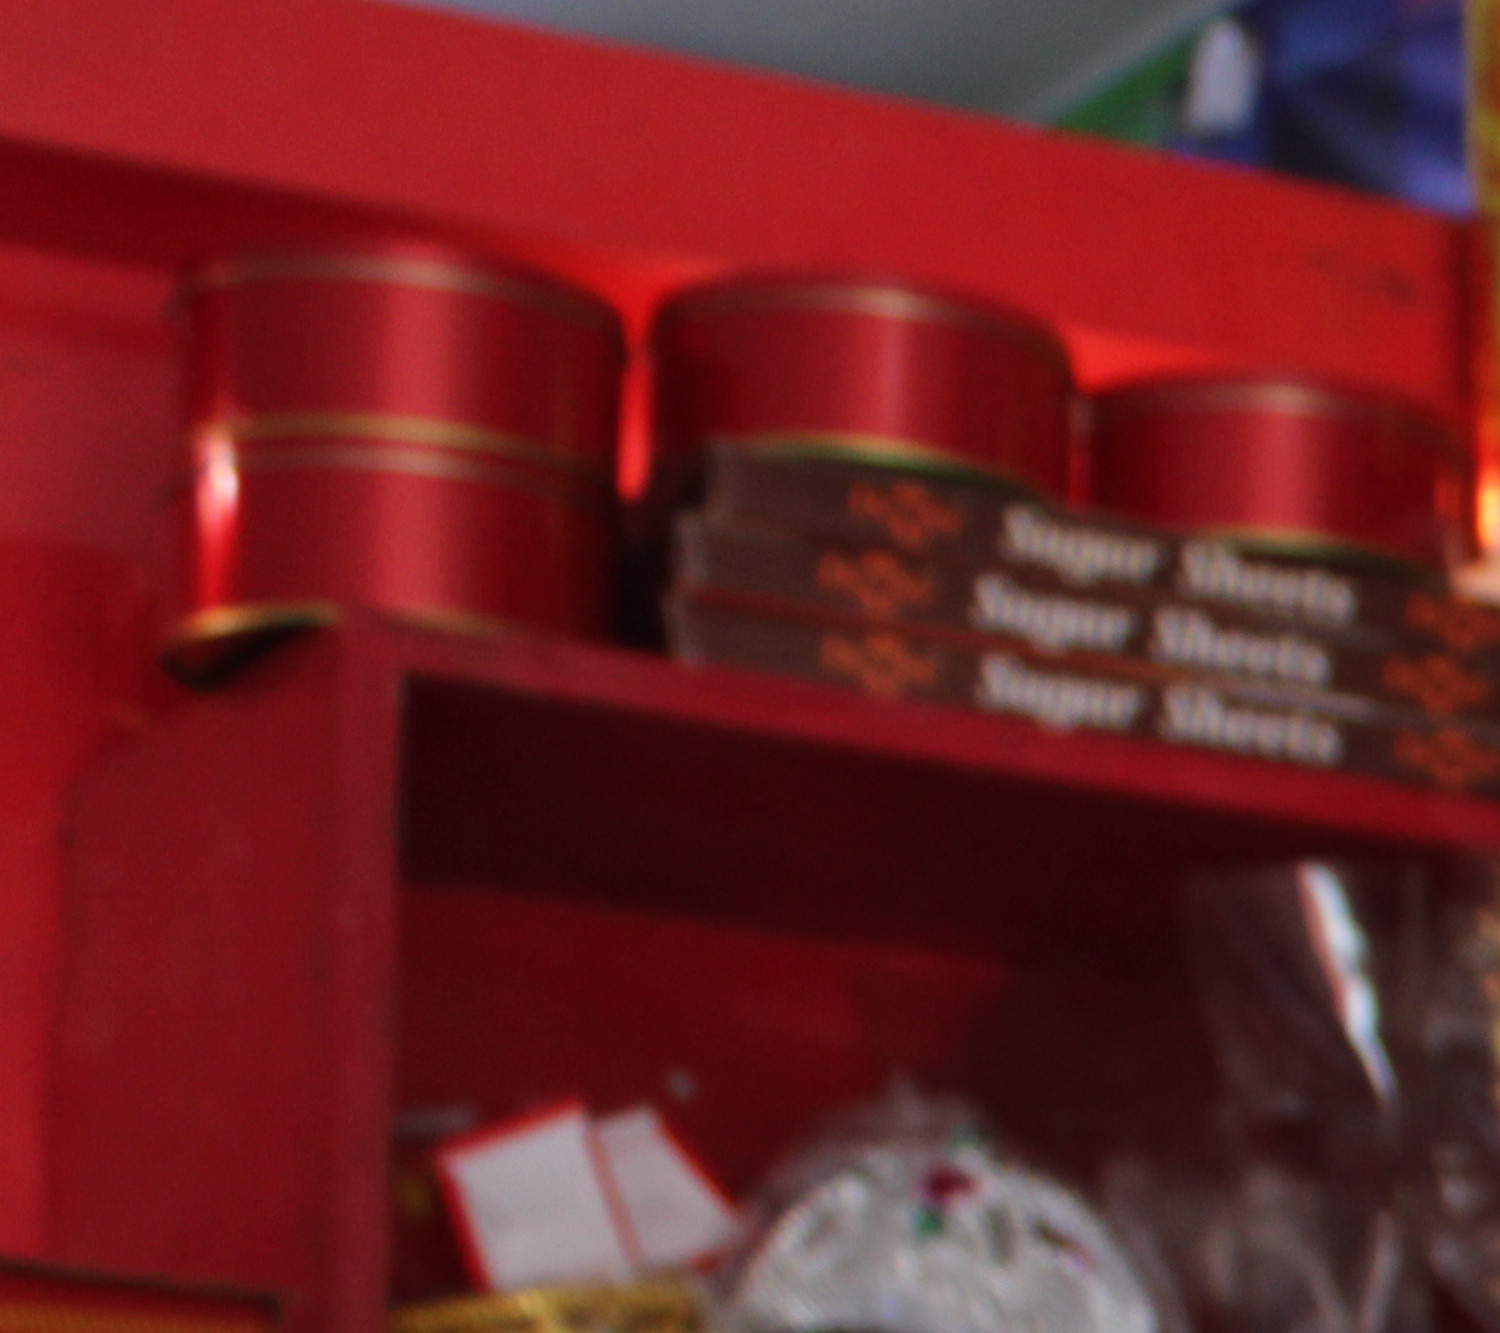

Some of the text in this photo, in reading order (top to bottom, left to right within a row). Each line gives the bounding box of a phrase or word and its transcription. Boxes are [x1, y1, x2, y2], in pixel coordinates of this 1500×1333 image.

[1001, 501, 1358, 624] Sugar Sheets
[973, 568, 1332, 690] Sugar Sheets
[977, 650, 1343, 766] Sugar Sheets
